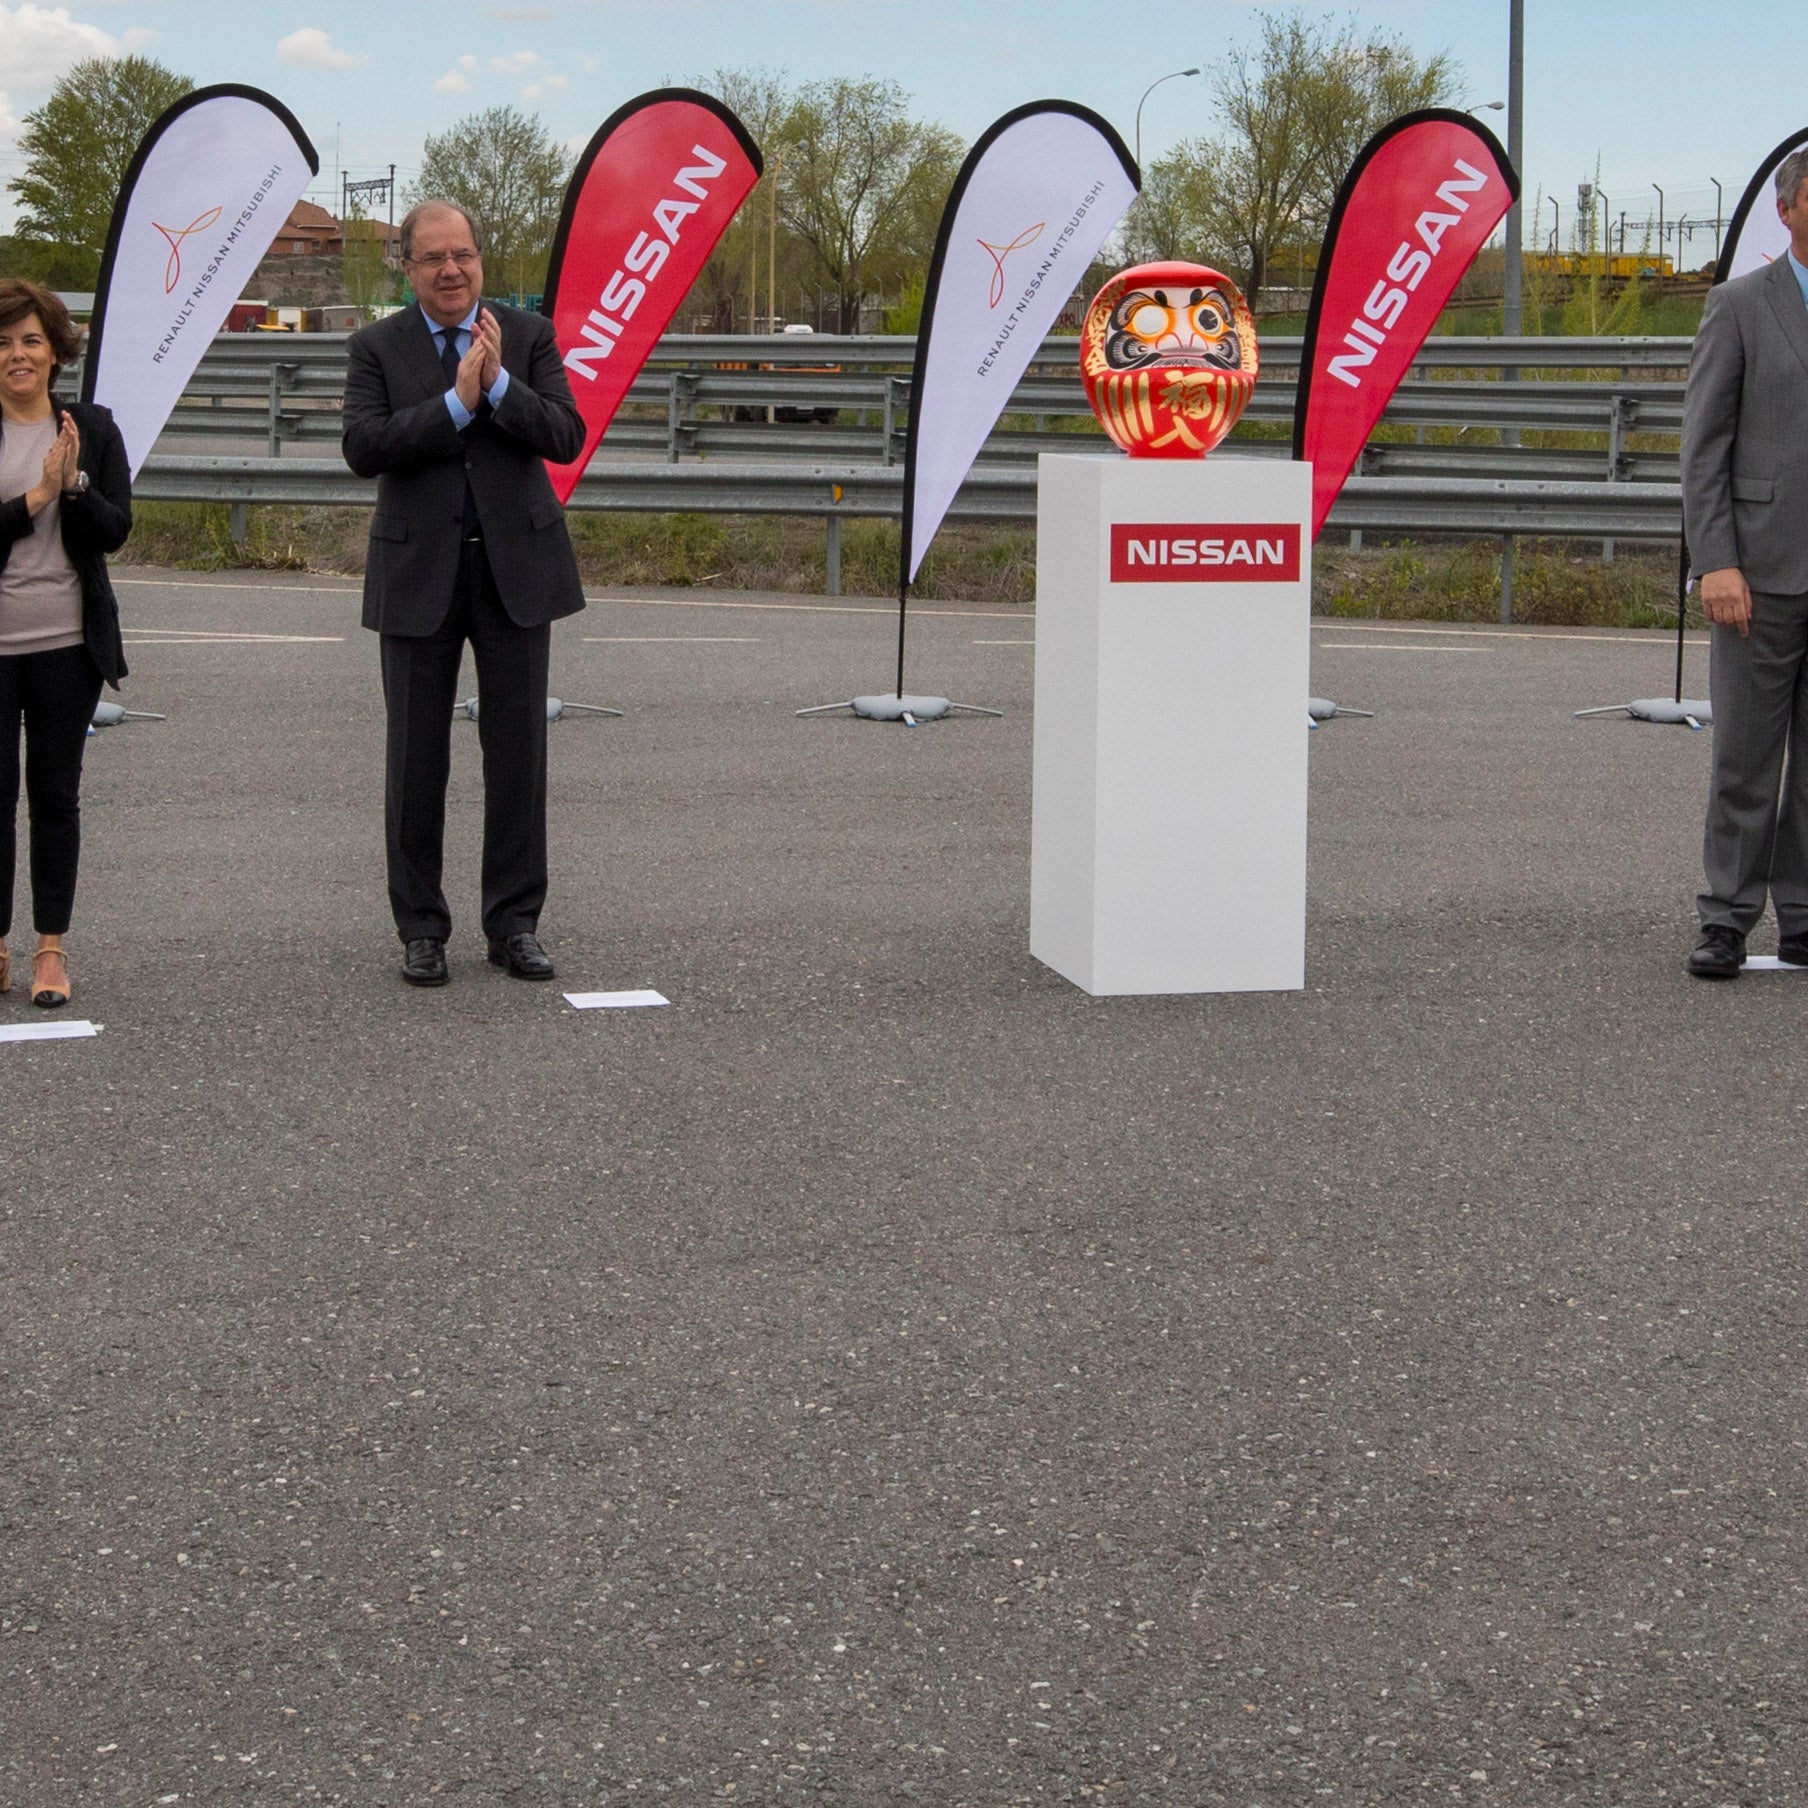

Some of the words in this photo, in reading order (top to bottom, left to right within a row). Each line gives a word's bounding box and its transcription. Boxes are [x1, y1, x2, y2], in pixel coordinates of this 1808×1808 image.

[152, 300, 197, 364] RENAULT
[193, 245, 231, 299] NISSAN
[228, 164, 283, 244] MITSUBISHI
[562, 144, 728, 382] NISSAN
[977, 313, 1020, 377] RENAULT
[1015, 260, 1053, 314] NISSAN
[1049, 180, 1106, 260] MITSUBISHI
[1326, 157, 1489, 389] NISSAN
[1128, 539, 1285, 565] NISSAN
